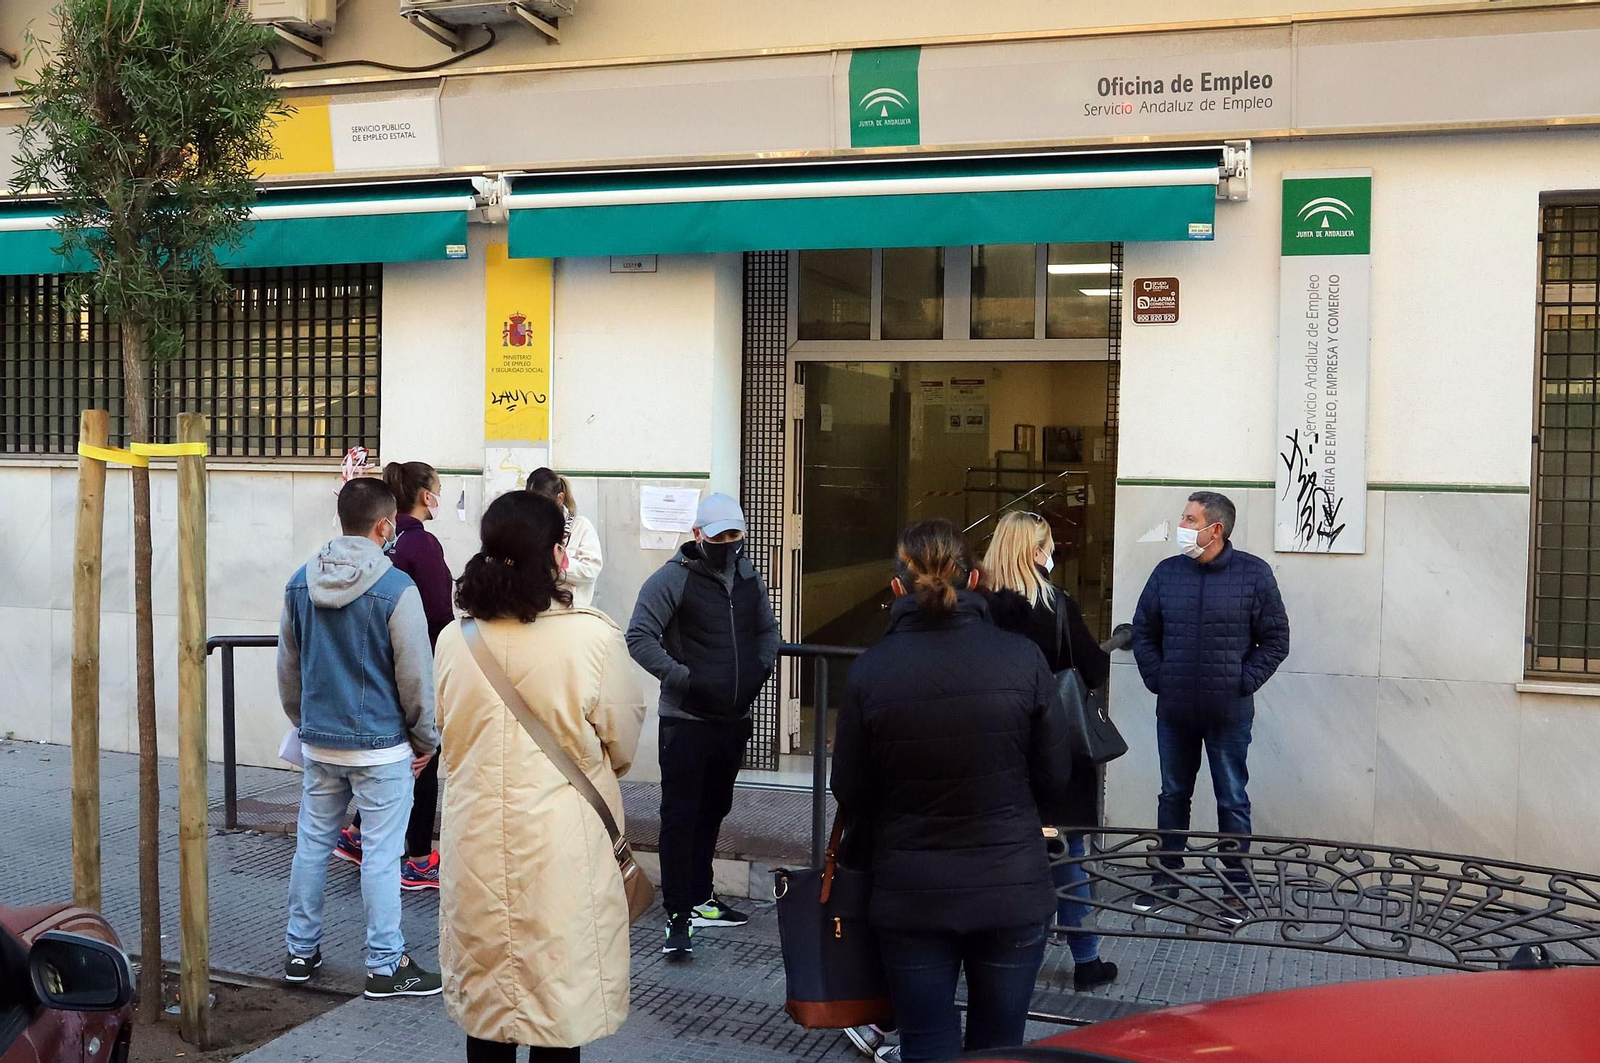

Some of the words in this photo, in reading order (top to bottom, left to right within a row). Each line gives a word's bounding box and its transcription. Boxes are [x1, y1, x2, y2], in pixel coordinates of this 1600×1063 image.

[1097, 75, 1164, 97] Oficina
[1170, 73, 1194, 93] de
[1200, 70, 1274, 95] Empleo
[1083, 101, 1133, 117] Servicio
[1138, 99, 1194, 114] Andaluz
[1199, 98, 1216, 111] de
[1222, 95, 1274, 113] Empleo
[350, 124, 381, 134] SERVICIO
[381, 122, 411, 132] PÚBLICO
[352, 134, 362, 142] DE
[362, 132, 389, 142] EMPLEO
[389, 131, 417, 140] ESTATAL
[1315, 230, 1323, 238] DE
[1305, 274, 1323, 319] Empleo
[1327, 274, 1340, 334] COMERCIO
[1305, 322, 1319, 338] de
[1304, 340, 1319, 390] Andaluz
[1326, 345, 1339, 396] EMPRESA
[1302, 392, 1318, 438] Servicio
[1324, 399, 1339, 447] EMPLEO,
[1324, 447, 1336, 465] DE
